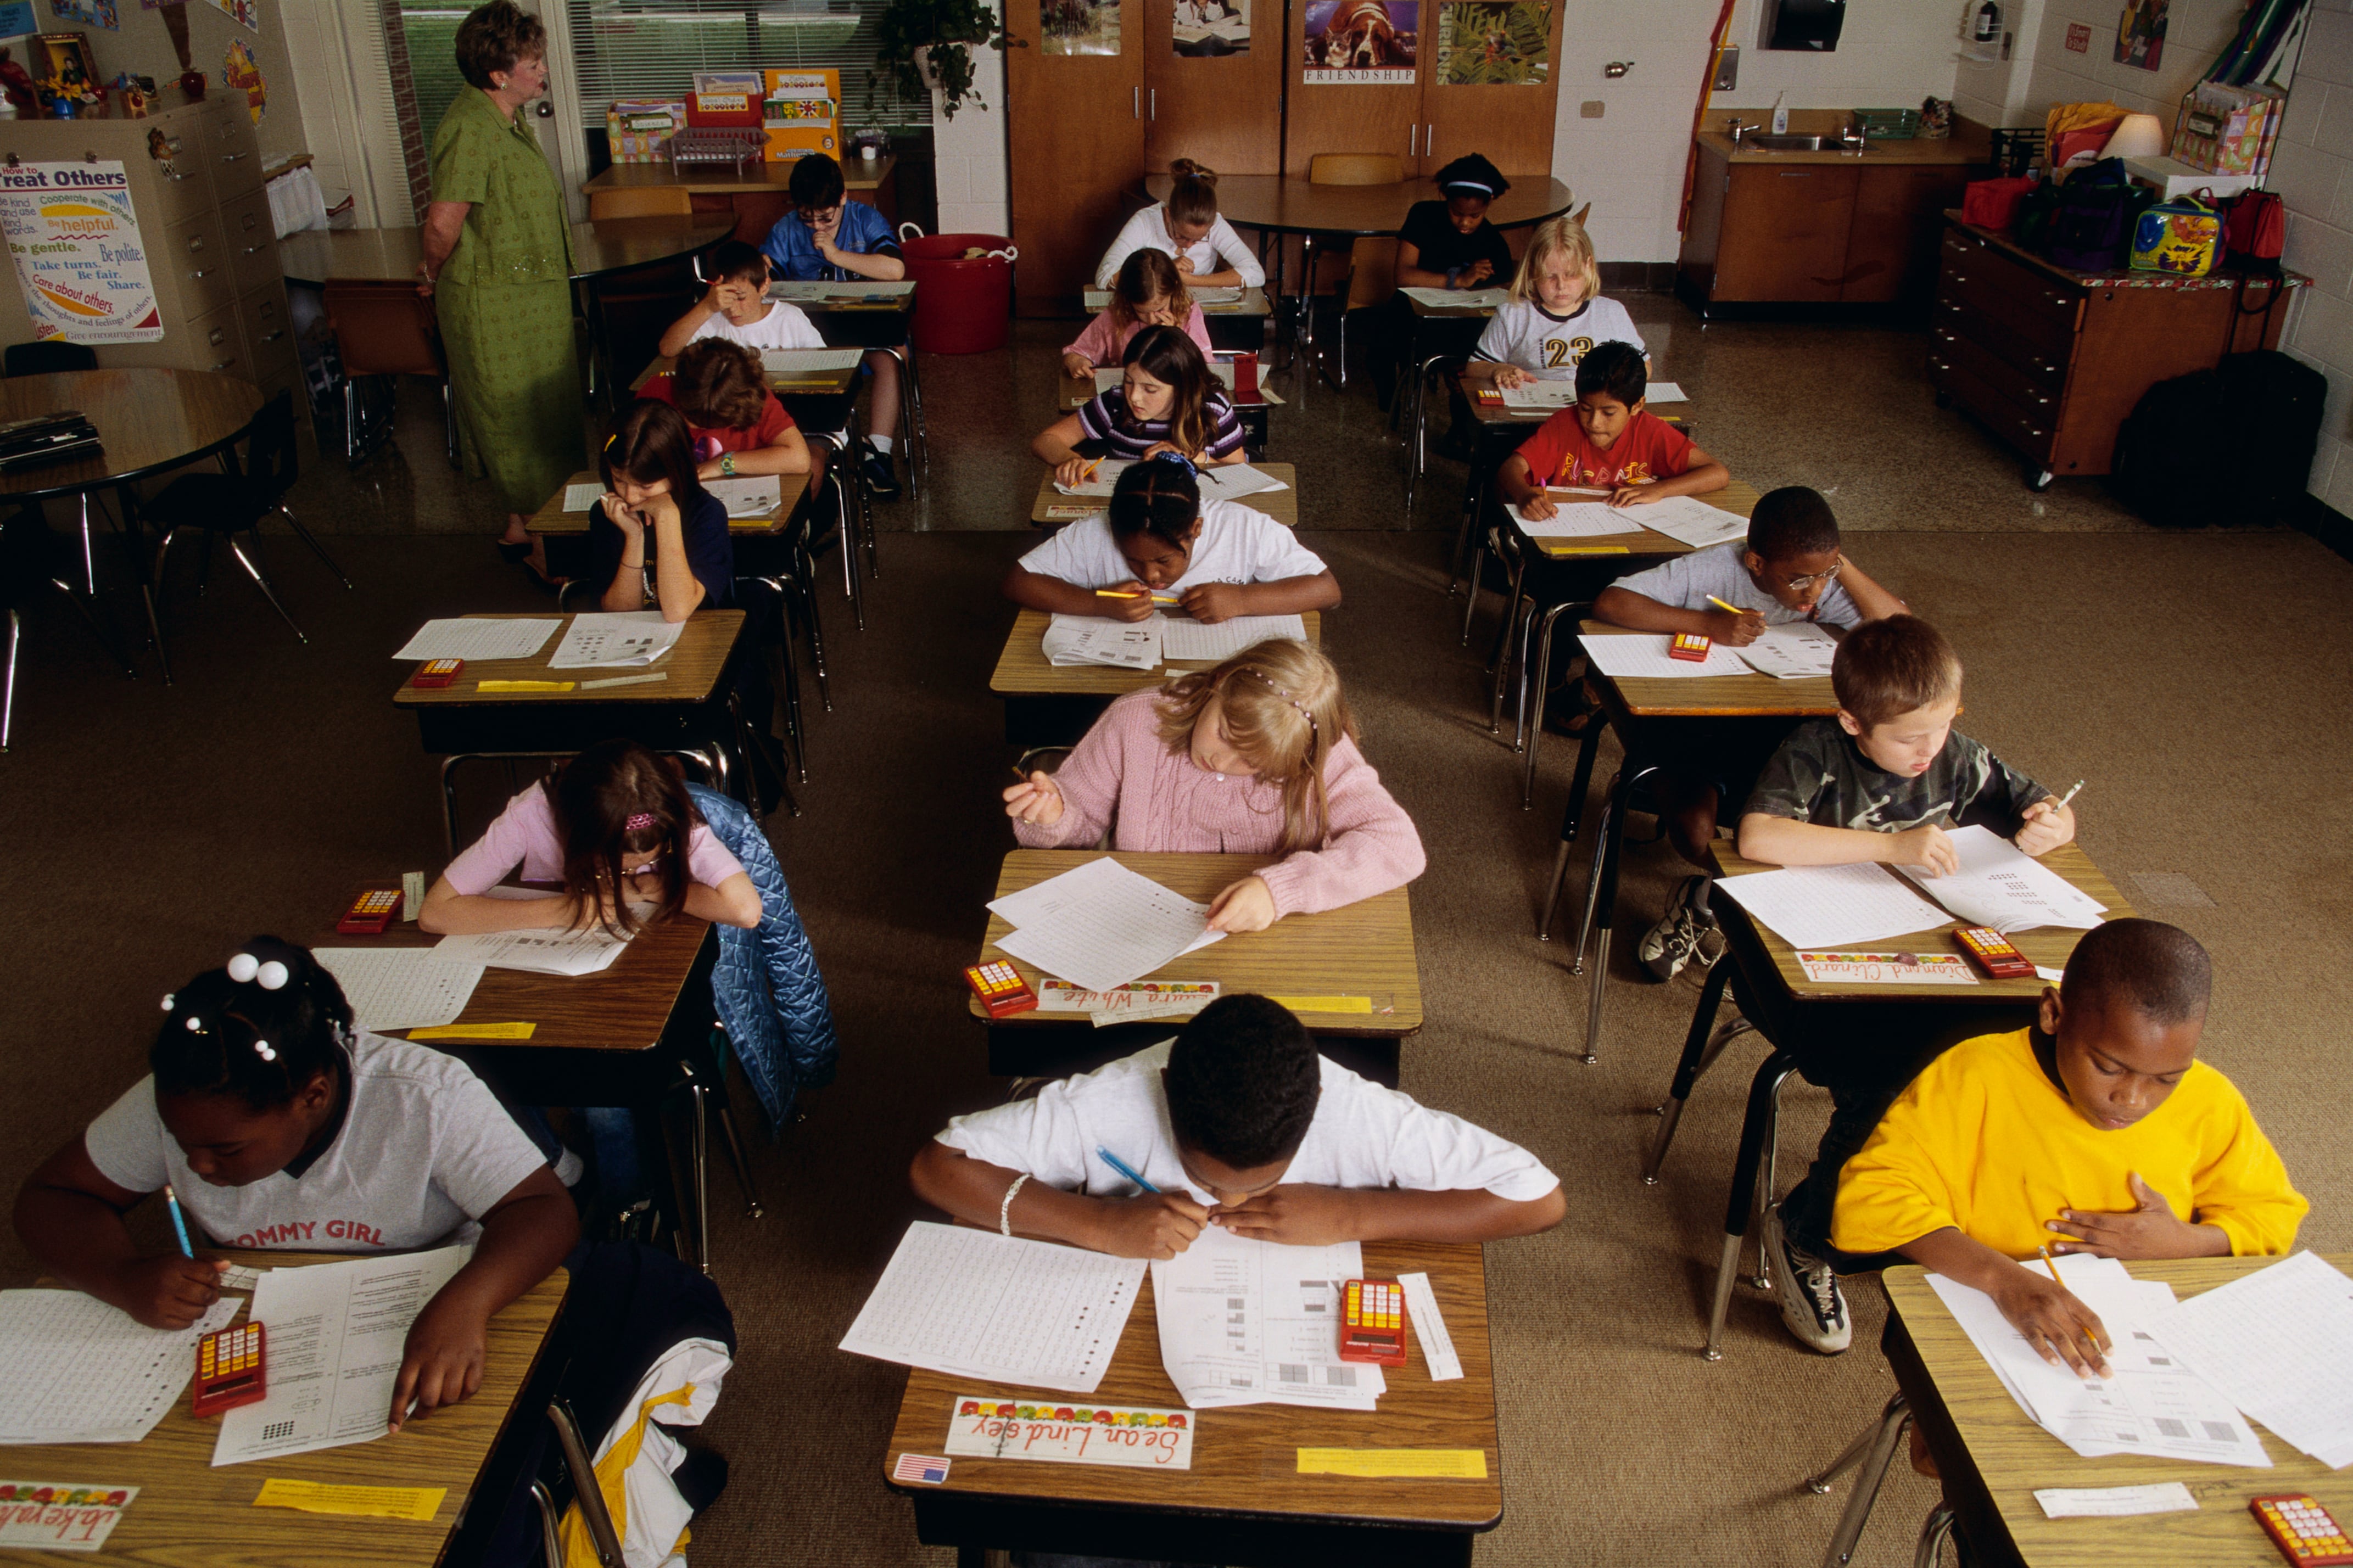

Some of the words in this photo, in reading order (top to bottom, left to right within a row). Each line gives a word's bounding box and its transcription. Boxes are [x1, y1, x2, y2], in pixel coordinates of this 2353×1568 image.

[1306, 70, 1412, 80] FRIENDSHIP
[824, 138, 832, 149] 3
[0, 172, 48, 187] reat
[54, 170, 126, 186] Others
[9, 197, 30, 207] kind
[40, 194, 88, 205] Cooperate
[91, 198, 108, 208] with
[0, 209, 18, 217] and
[3, 218, 21, 227] kind
[5, 224, 38, 236] words.
[61, 217, 119, 233] helpful.
[10, 243, 26, 253] Be
[31, 242, 81, 255] gentle.
[99, 244, 113, 262] Be
[115, 242, 144, 266] polite.
[31, 261, 60, 270] Take
[77, 271, 92, 279] Be
[96, 270, 122, 279] fair.
[107, 281, 145, 289] Share.
[33, 274, 53, 289] Care
[55, 281, 82, 301] about
[84, 292, 114, 315] others.
[32, 289, 42, 301] the
[43, 301, 75, 322] thoughts
[96, 317, 125, 327] feelings
[126, 309, 134, 320] of
[133, 295, 153, 314] others.
[32, 320, 59, 340] Listen.
[66, 331, 86, 340] Give
[1545, 336, 1594, 368] 23
[1890, 964, 1977, 982] Diamond
[1063, 991, 1132, 1010] White
[326, 1220, 385, 1246] GIRL
[971, 1416, 1093, 1457] Lindsey
[1104, 1427, 1180, 1464] Sean
